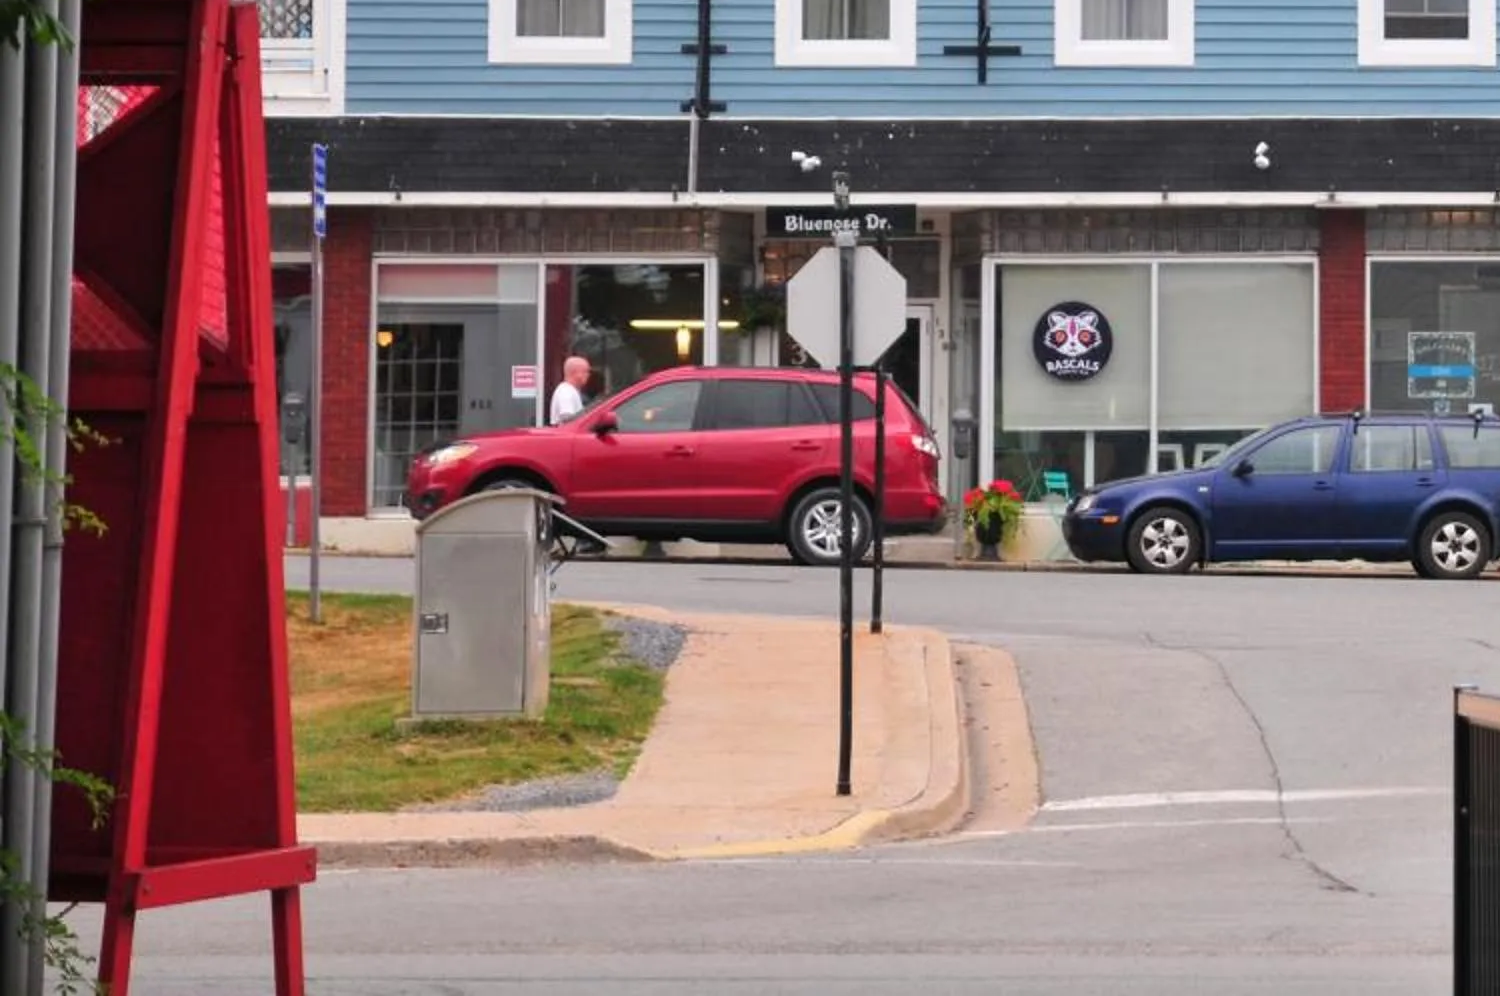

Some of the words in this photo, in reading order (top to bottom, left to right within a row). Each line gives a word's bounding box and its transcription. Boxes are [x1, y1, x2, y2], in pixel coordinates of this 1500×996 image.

[784, 214, 861, 232] Bluenose
[865, 212, 892, 230] Dr.
[1045, 359, 1100, 372] RASCALS
